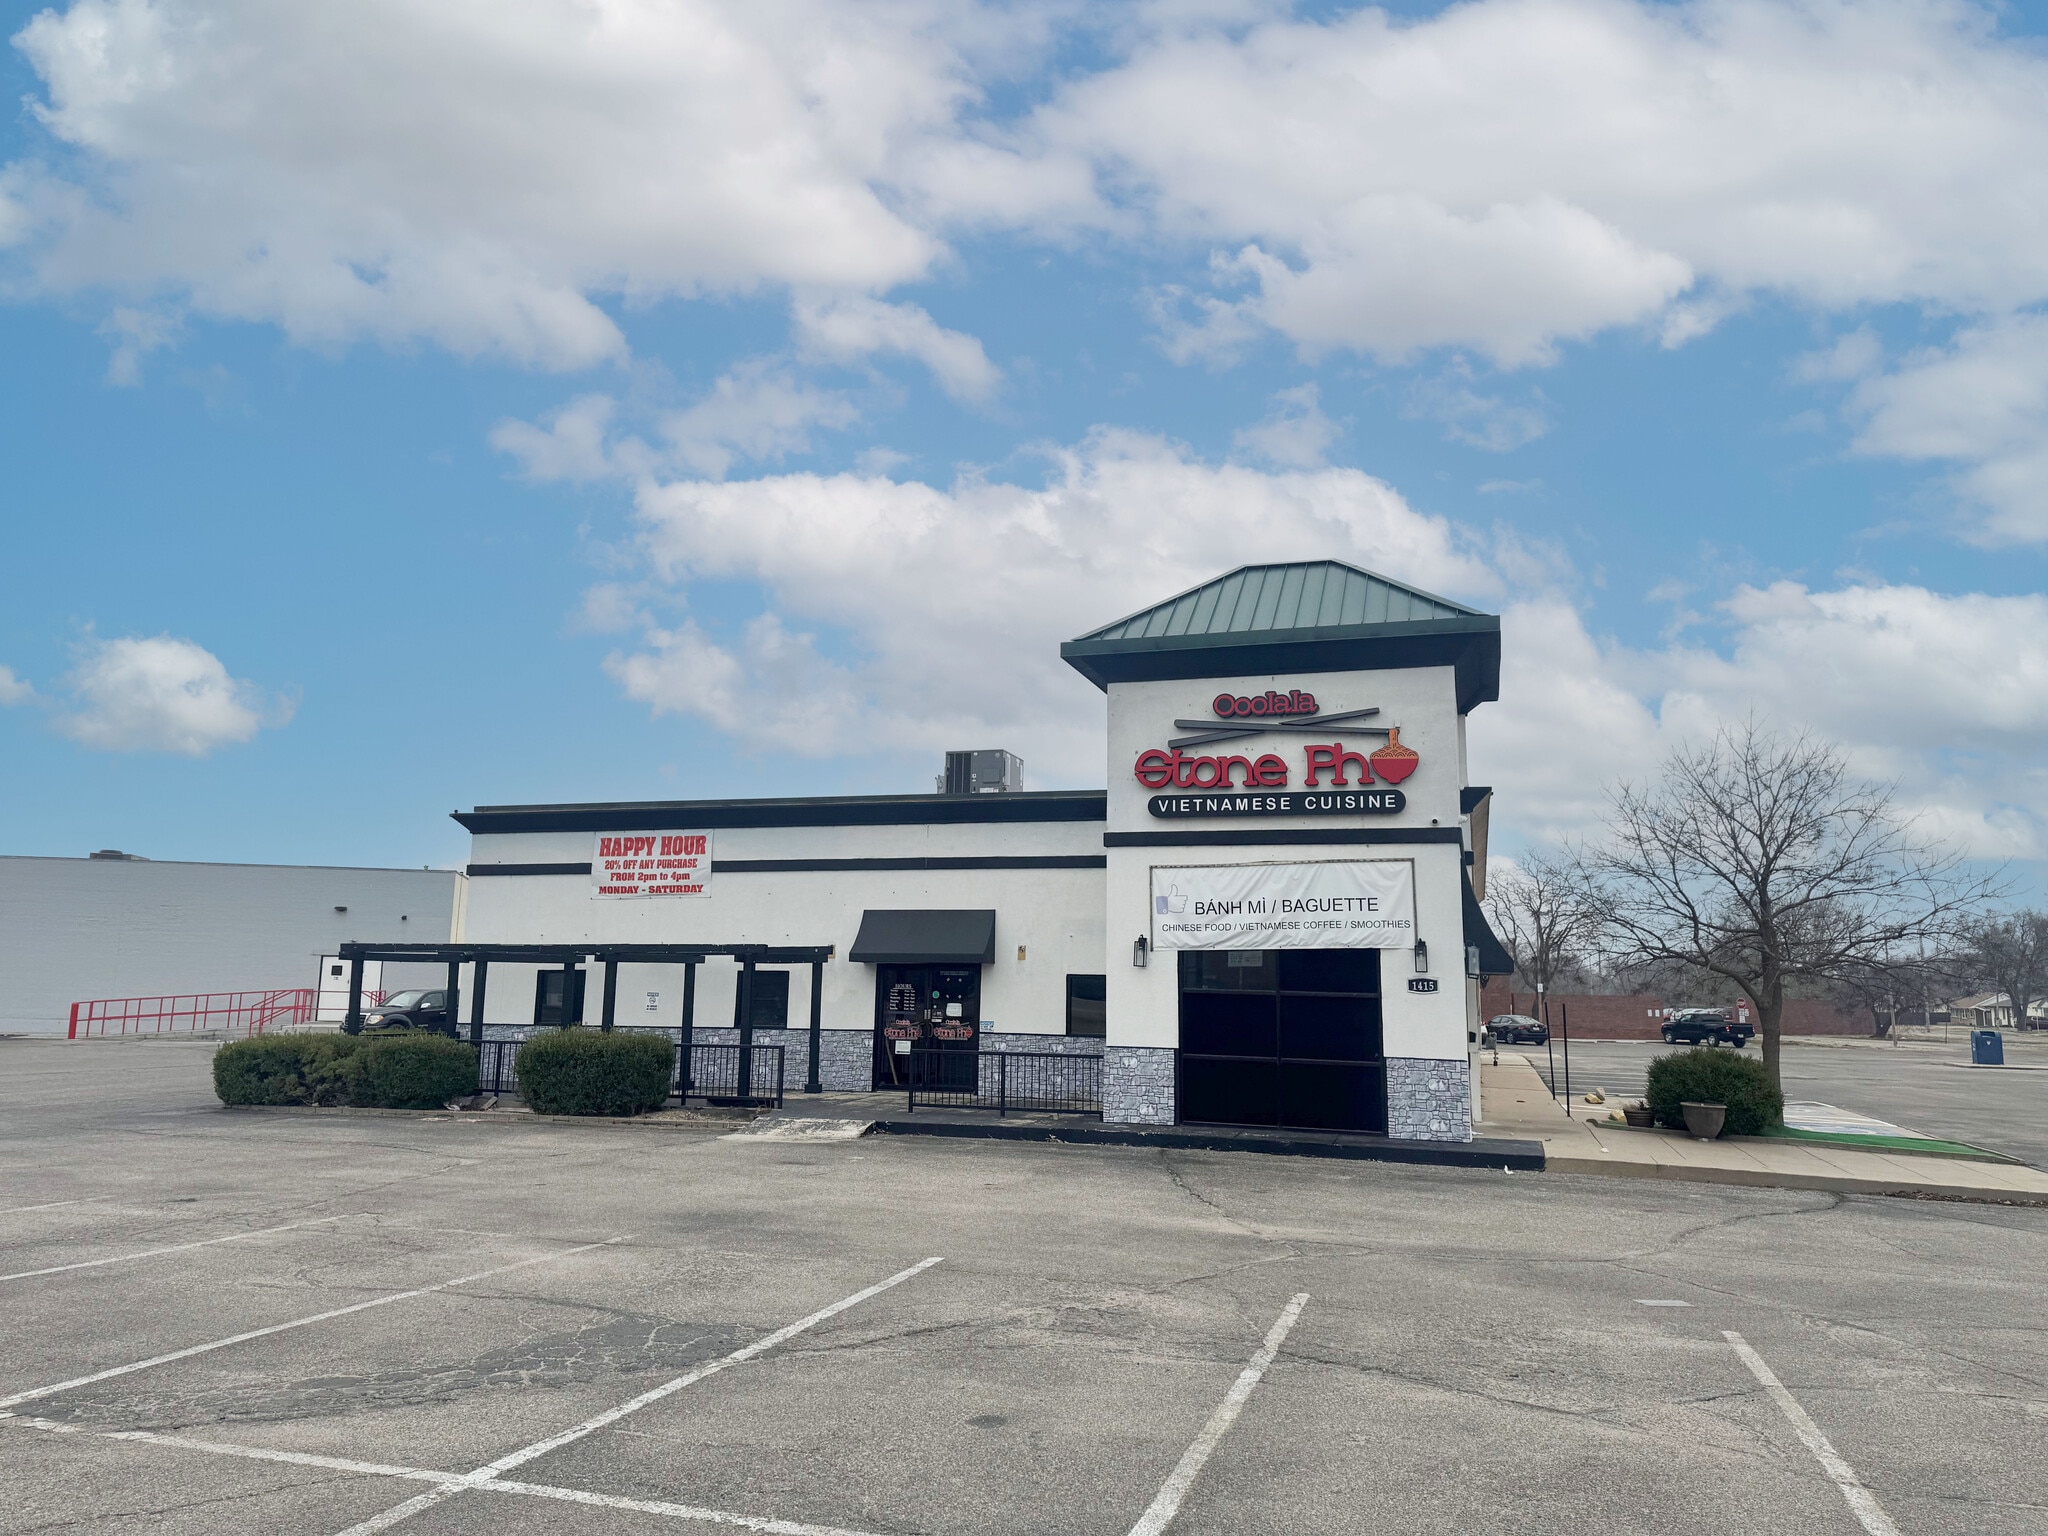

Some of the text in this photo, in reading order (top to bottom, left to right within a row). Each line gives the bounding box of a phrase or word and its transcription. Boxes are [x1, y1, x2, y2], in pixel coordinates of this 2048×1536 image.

[1213, 690, 1320, 718] Ooolala
[1135, 748, 1287, 788] Stone
[1157, 794, 1396, 813] VIETNAMESE CUISINE
[599, 835, 707, 857] HAPPY HOUR
[604, 858, 698, 870] 20% OFF ANY PURCHASE
[610, 871, 690, 883] FROM 2pm to 4pm
[598, 886, 639, 895] MONDAY
[648, 884, 704, 894] SATURDAY
[1194, 898, 1242, 915] BÁNH
[1271, 899, 1277, 914] /
[1282, 897, 1379, 913] BAGUETTE
[1161, 923, 1202, 932] CHINESE
[1204, 923, 1231, 932] FOOD
[1239, 921, 1300, 931] VIETNAMESE
[1303, 920, 1341, 930] COFFEE
[1350, 919, 1411, 929] SMOOTHIES
[1411, 981, 1434, 991] 1415
